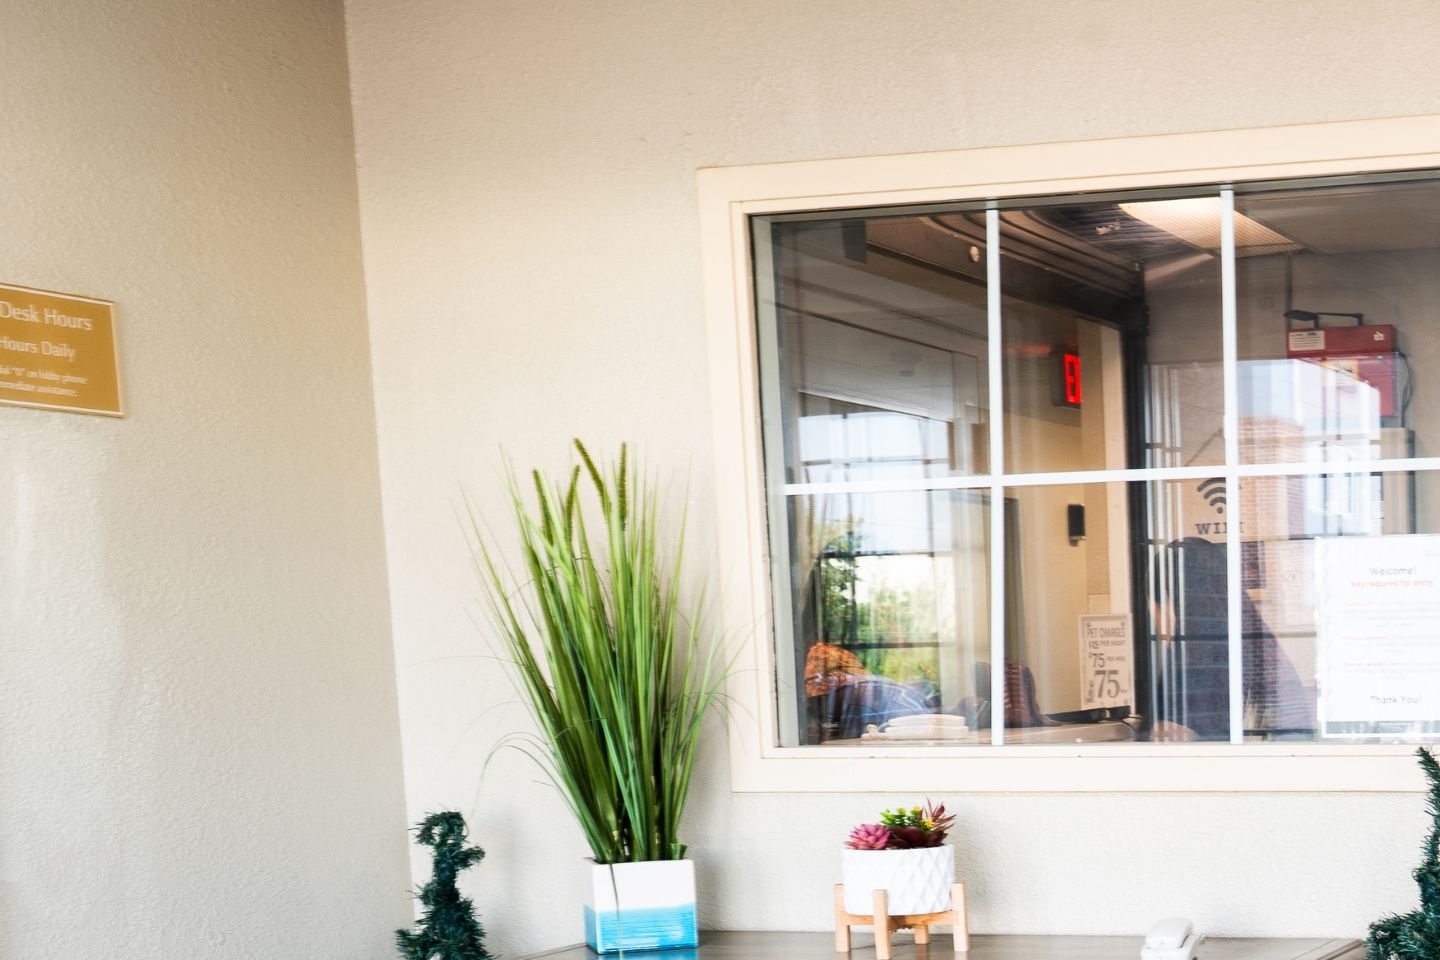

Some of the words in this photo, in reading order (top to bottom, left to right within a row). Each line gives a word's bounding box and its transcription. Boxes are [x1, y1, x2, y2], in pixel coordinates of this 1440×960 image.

[0, 301, 40, 322] Desk
[44, 308, 94, 331] Hours
[41, 341, 75, 362] Daily
